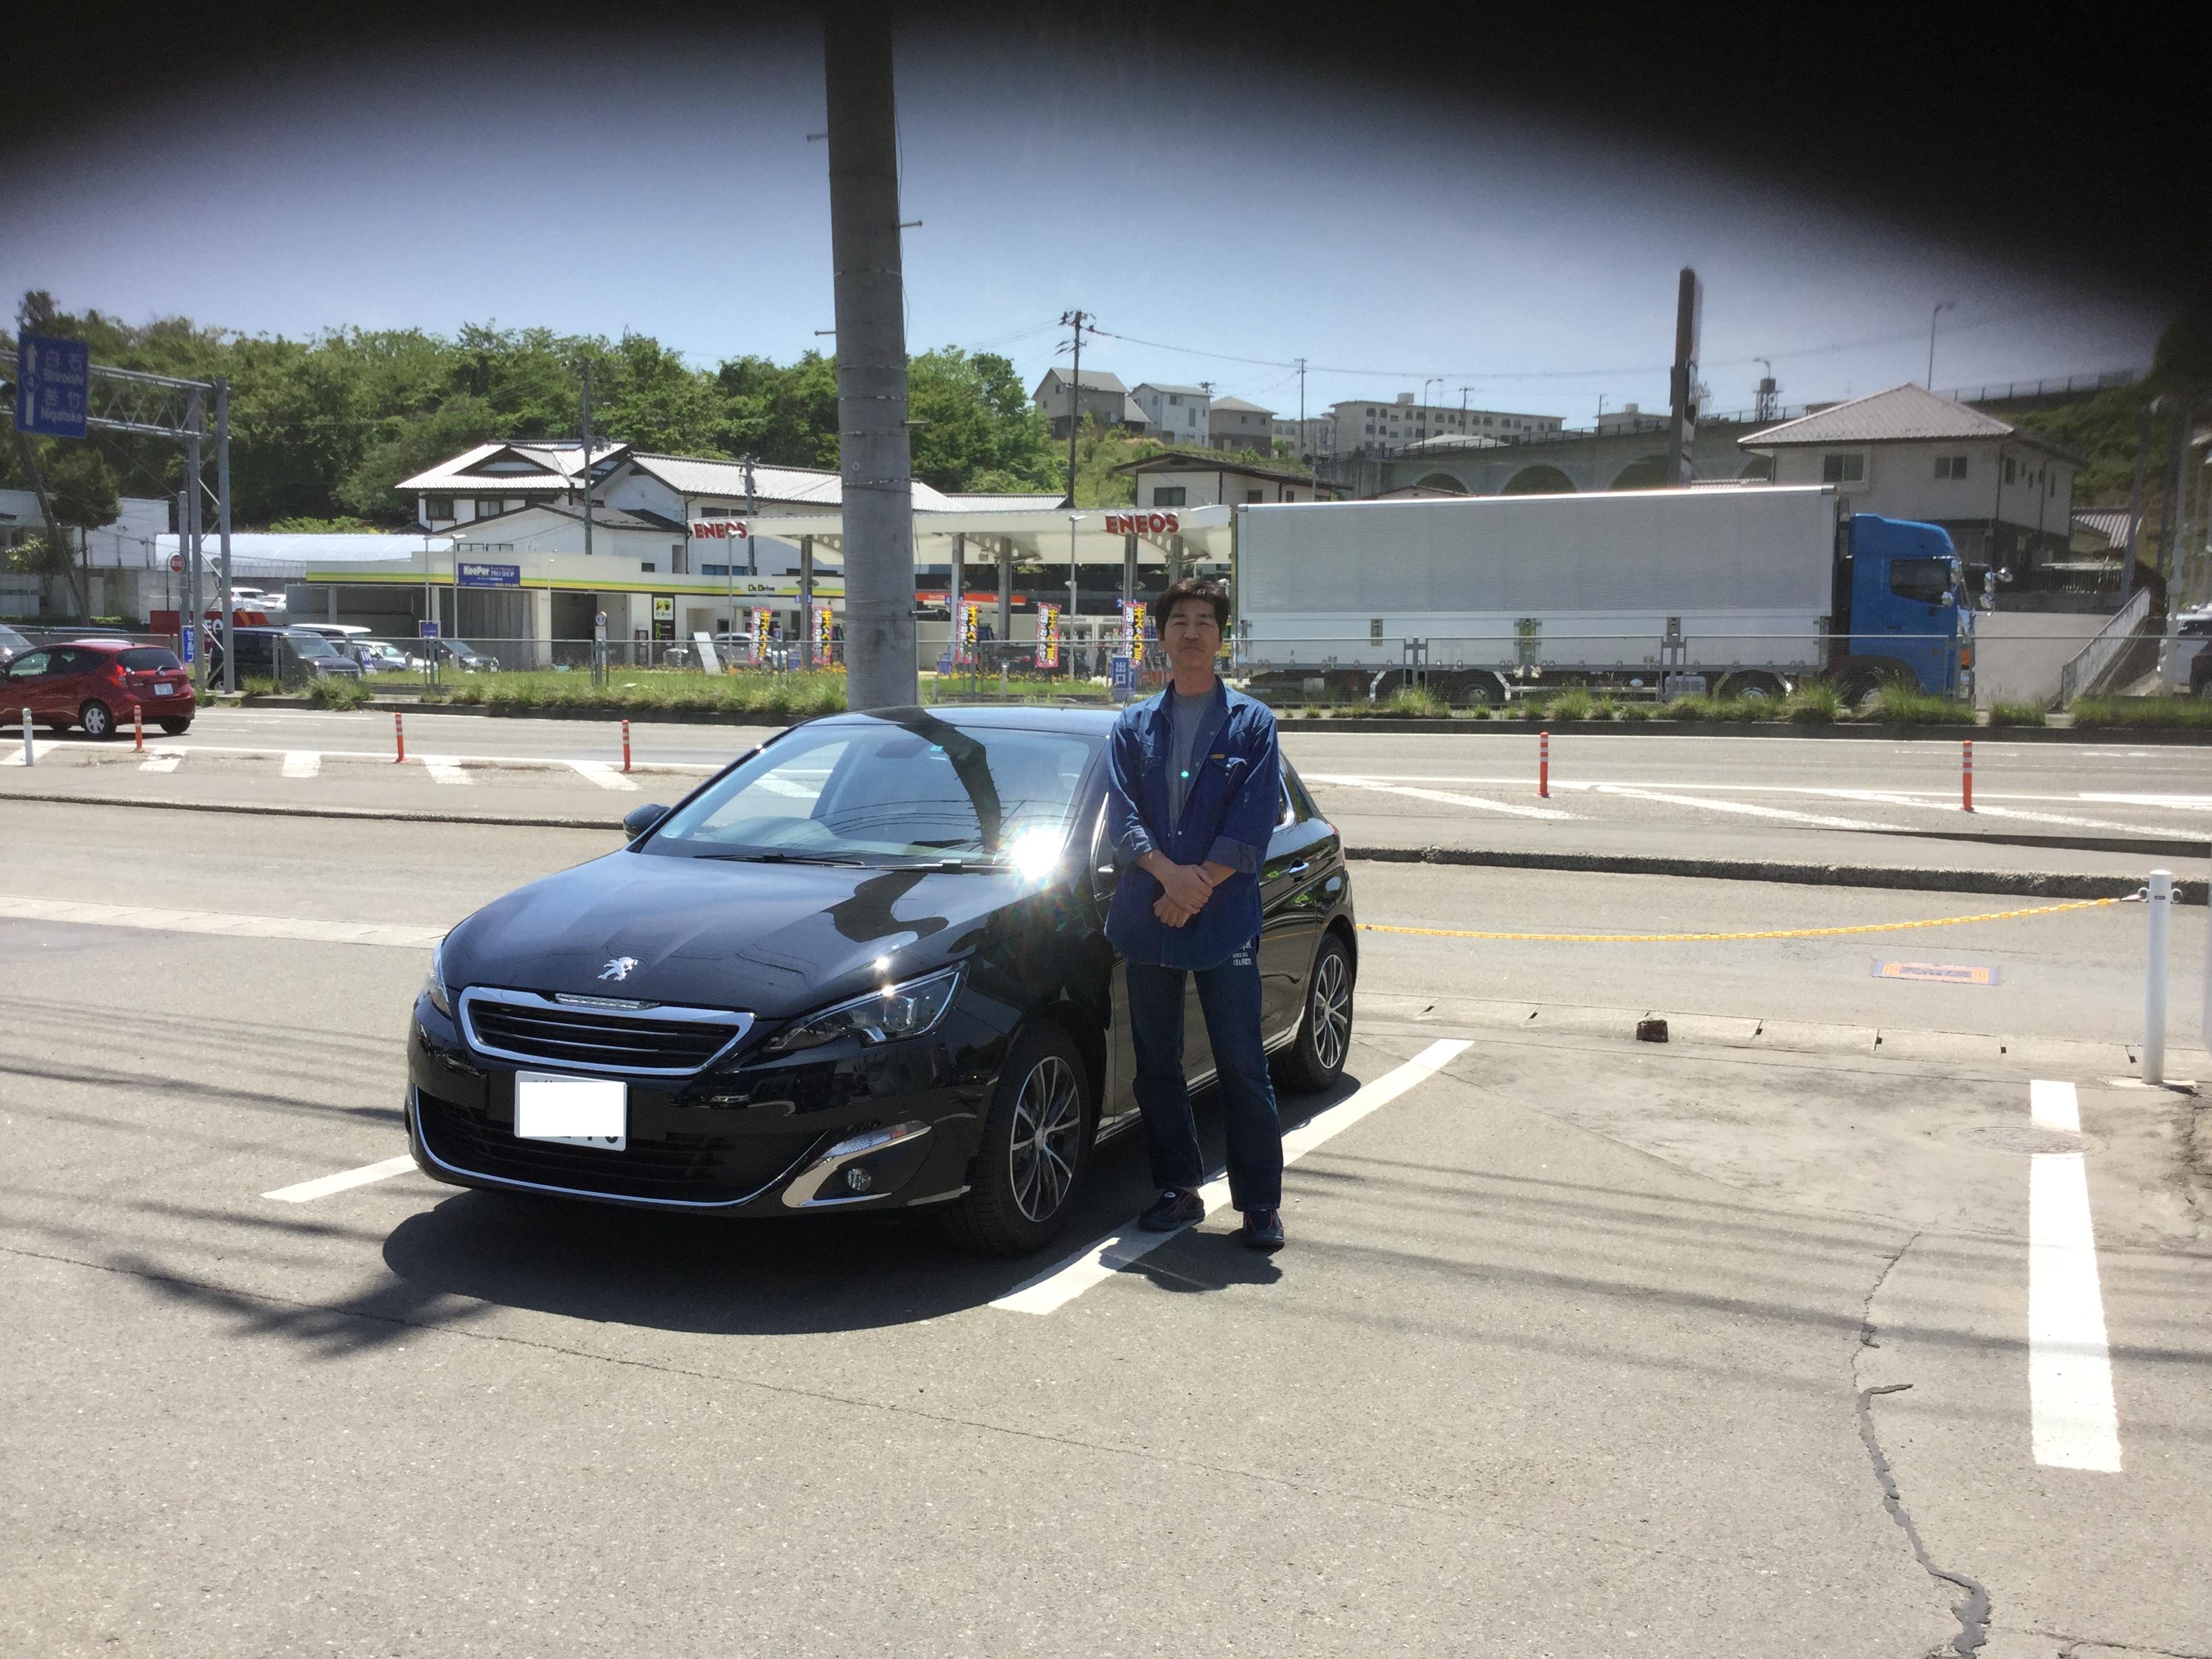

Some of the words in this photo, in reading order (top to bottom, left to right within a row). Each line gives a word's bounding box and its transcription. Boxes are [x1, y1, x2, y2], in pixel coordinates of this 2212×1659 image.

[694, 521, 747, 539] ENEOS
[1105, 513, 1179, 534] ENEOS
[1117, 598, 1123, 607] 2
[360, 651, 372, 661] IN
[1115, 661, 1126, 685] 出口
